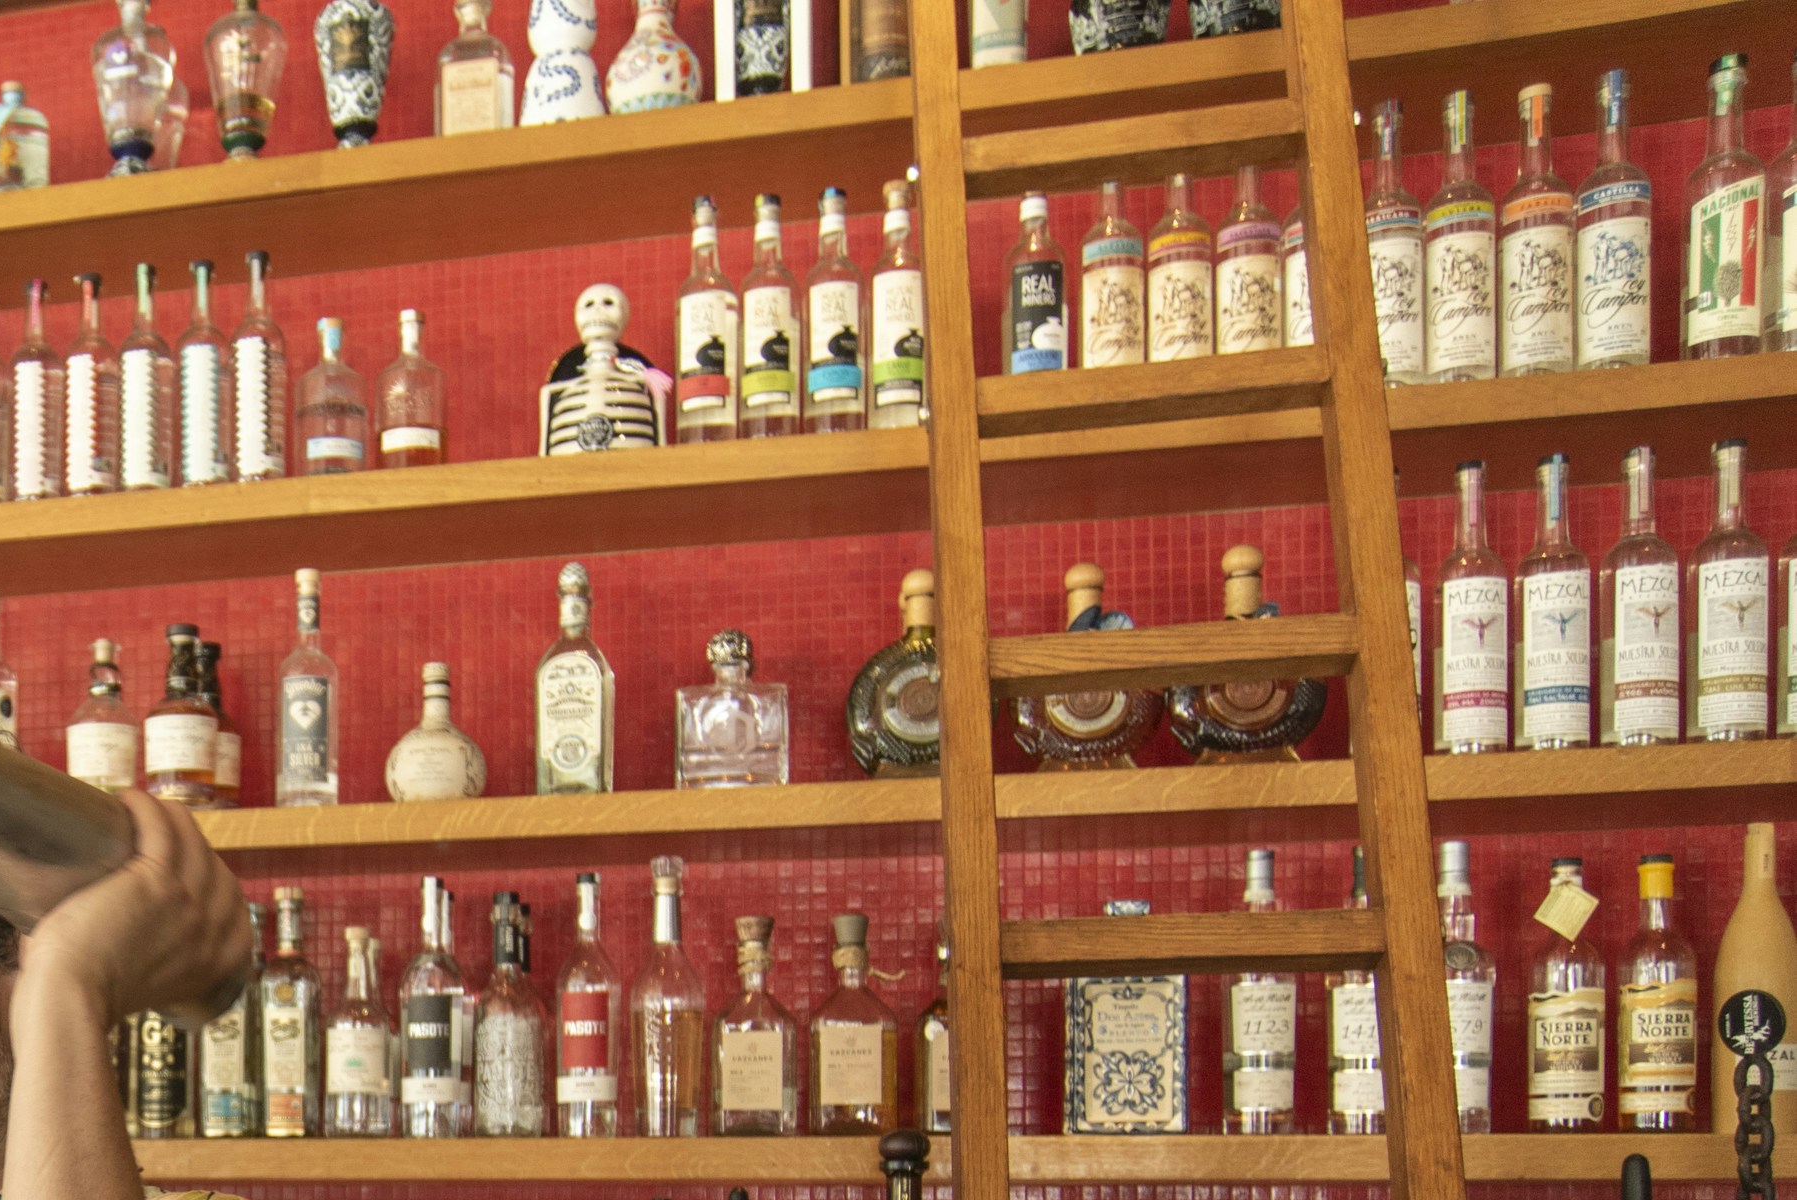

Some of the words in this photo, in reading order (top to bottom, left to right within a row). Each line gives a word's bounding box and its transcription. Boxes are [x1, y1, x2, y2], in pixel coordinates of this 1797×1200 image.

[1700, 181, 1760, 216] NACIONAL
[1021, 273, 1053, 294] REAL
[289, 752, 320, 767] SILVER
[1638, 1012, 1691, 1026] SIERRA
[141, 1019, 175, 1045] G4
[408, 1022, 450, 1038] PASOTE
[564, 1020, 606, 1037] PASOTE
[1242, 1019, 1290, 1036] 1123
[1540, 1021, 1593, 1035] SIERRA
[1640, 1024, 1689, 1038] NORTE
[1542, 1032, 1591, 1046] NORTE
